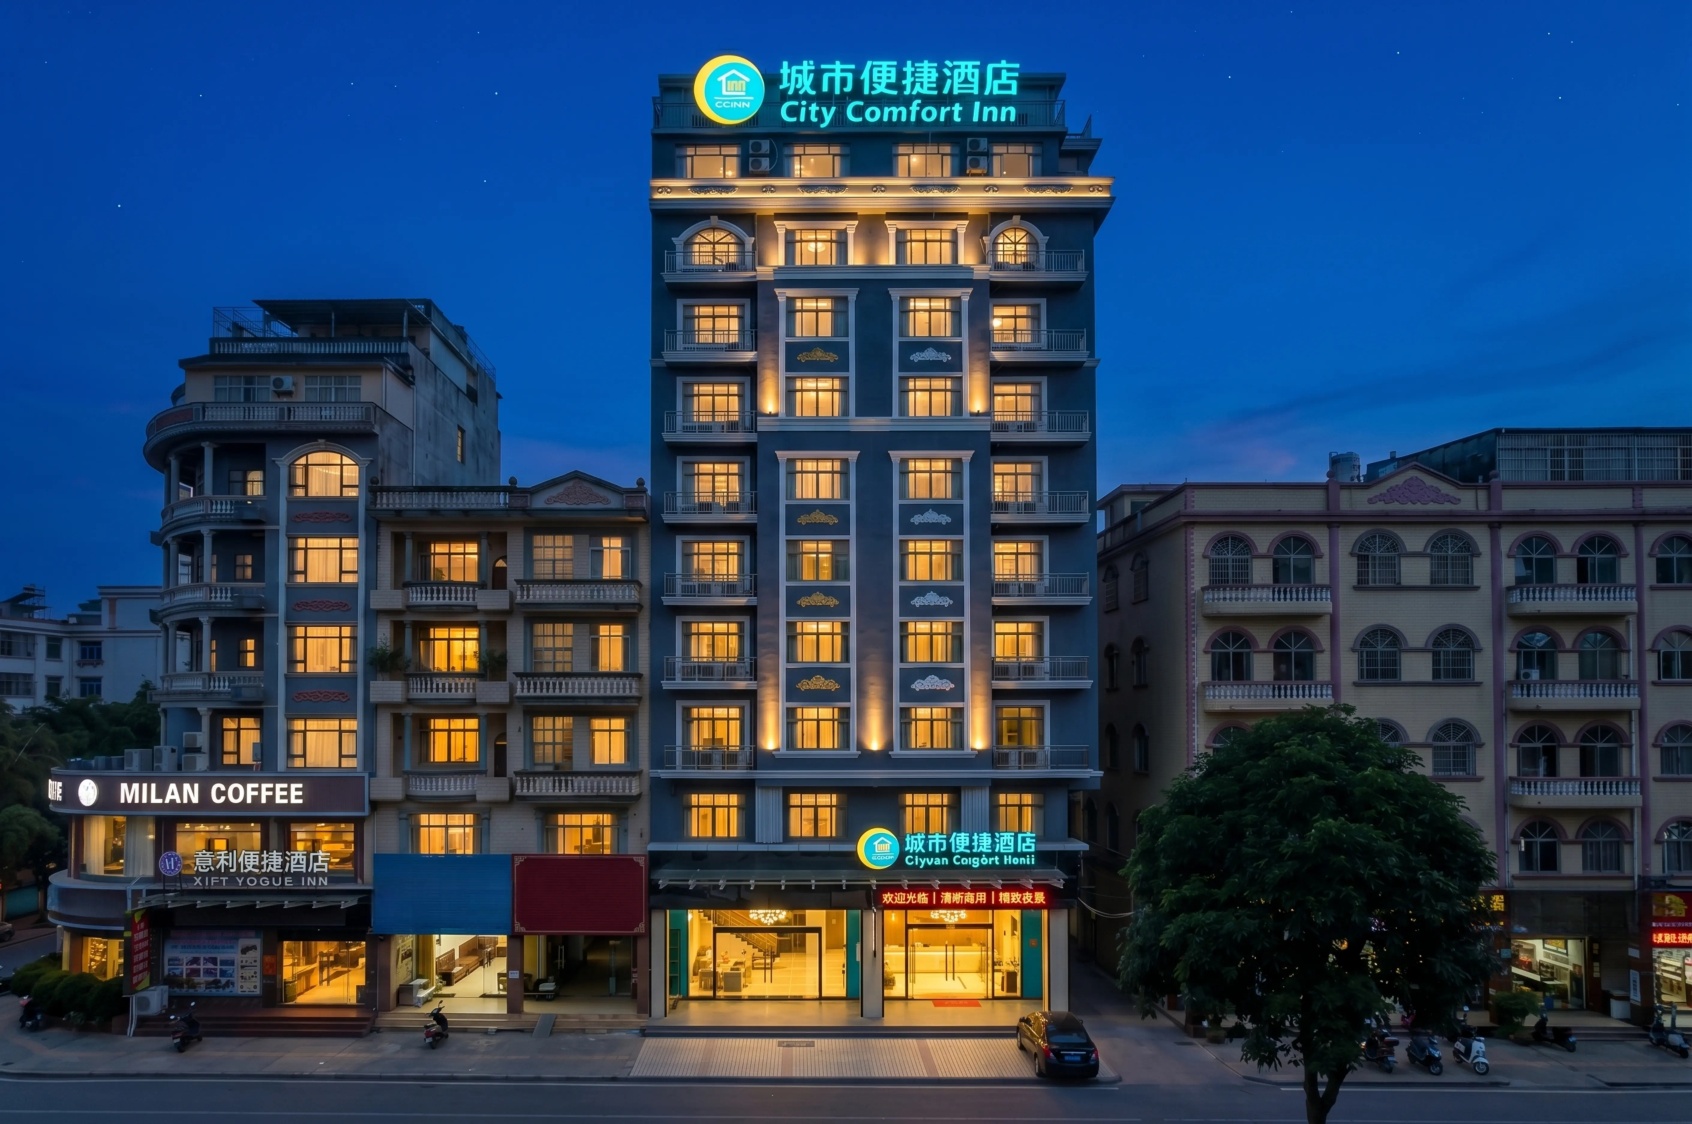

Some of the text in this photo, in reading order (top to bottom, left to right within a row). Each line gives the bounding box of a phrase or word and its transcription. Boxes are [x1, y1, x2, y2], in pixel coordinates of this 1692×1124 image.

[780, 60, 1020, 96] 城市便捷酒店
[780, 100, 1017, 128] City Comfort Inn
[120, 783, 304, 804] MILAN COFFEE
[905, 832, 1036, 853] 城市便捷酒店
[193, 850, 331, 873] 意利便捷酒店
[236, 876, 294, 887] YOGUE
[301, 876, 328, 887] INN
[882, 891, 929, 904] 欢迎光临
